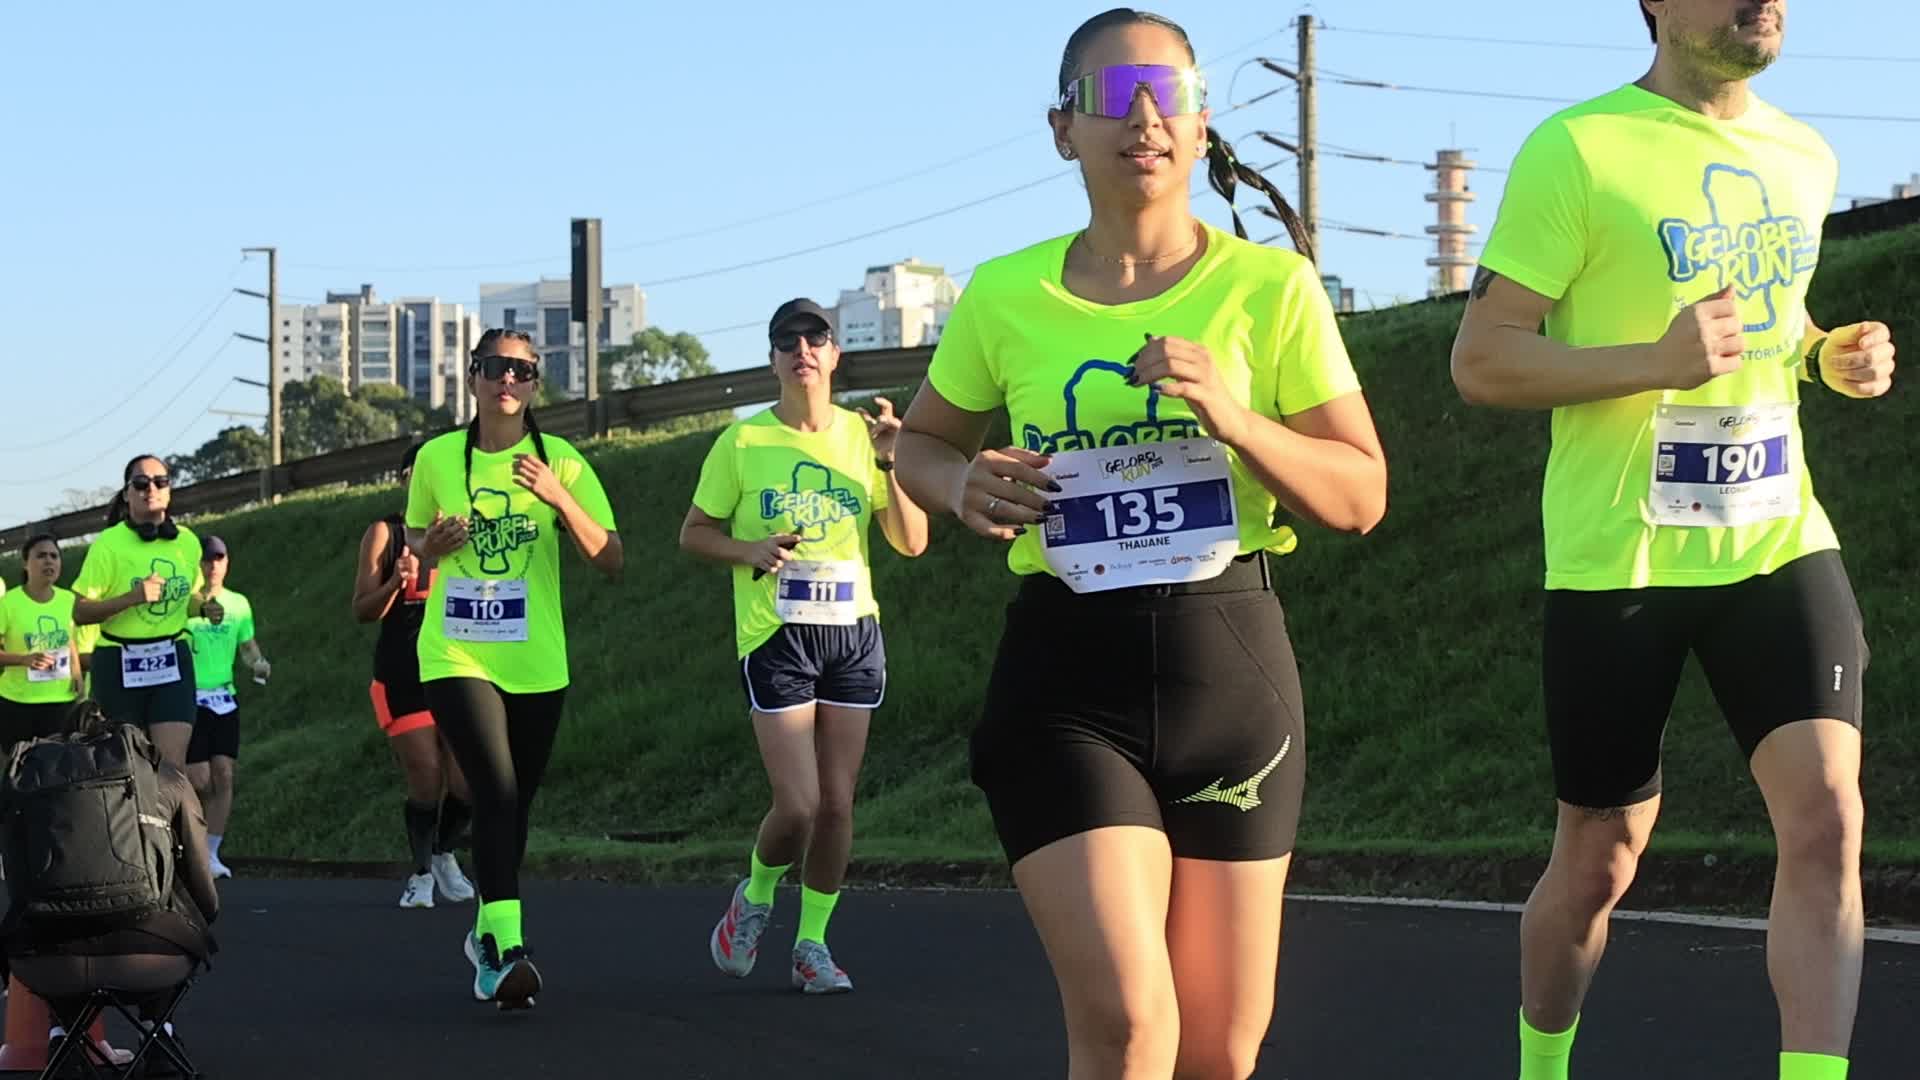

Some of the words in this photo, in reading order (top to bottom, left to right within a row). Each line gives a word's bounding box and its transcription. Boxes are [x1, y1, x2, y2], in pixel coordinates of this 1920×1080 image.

[1722, 246, 1792, 297] RUN
[1702, 442, 1767, 483] 190
[1096, 487, 1185, 538] 135
[473, 528, 517, 556] RUN
[1117, 535, 1171, 551] THAUANE
[808, 581, 837, 601] 111
[469, 600, 505, 620] 110
[138, 655, 168, 672] 422
